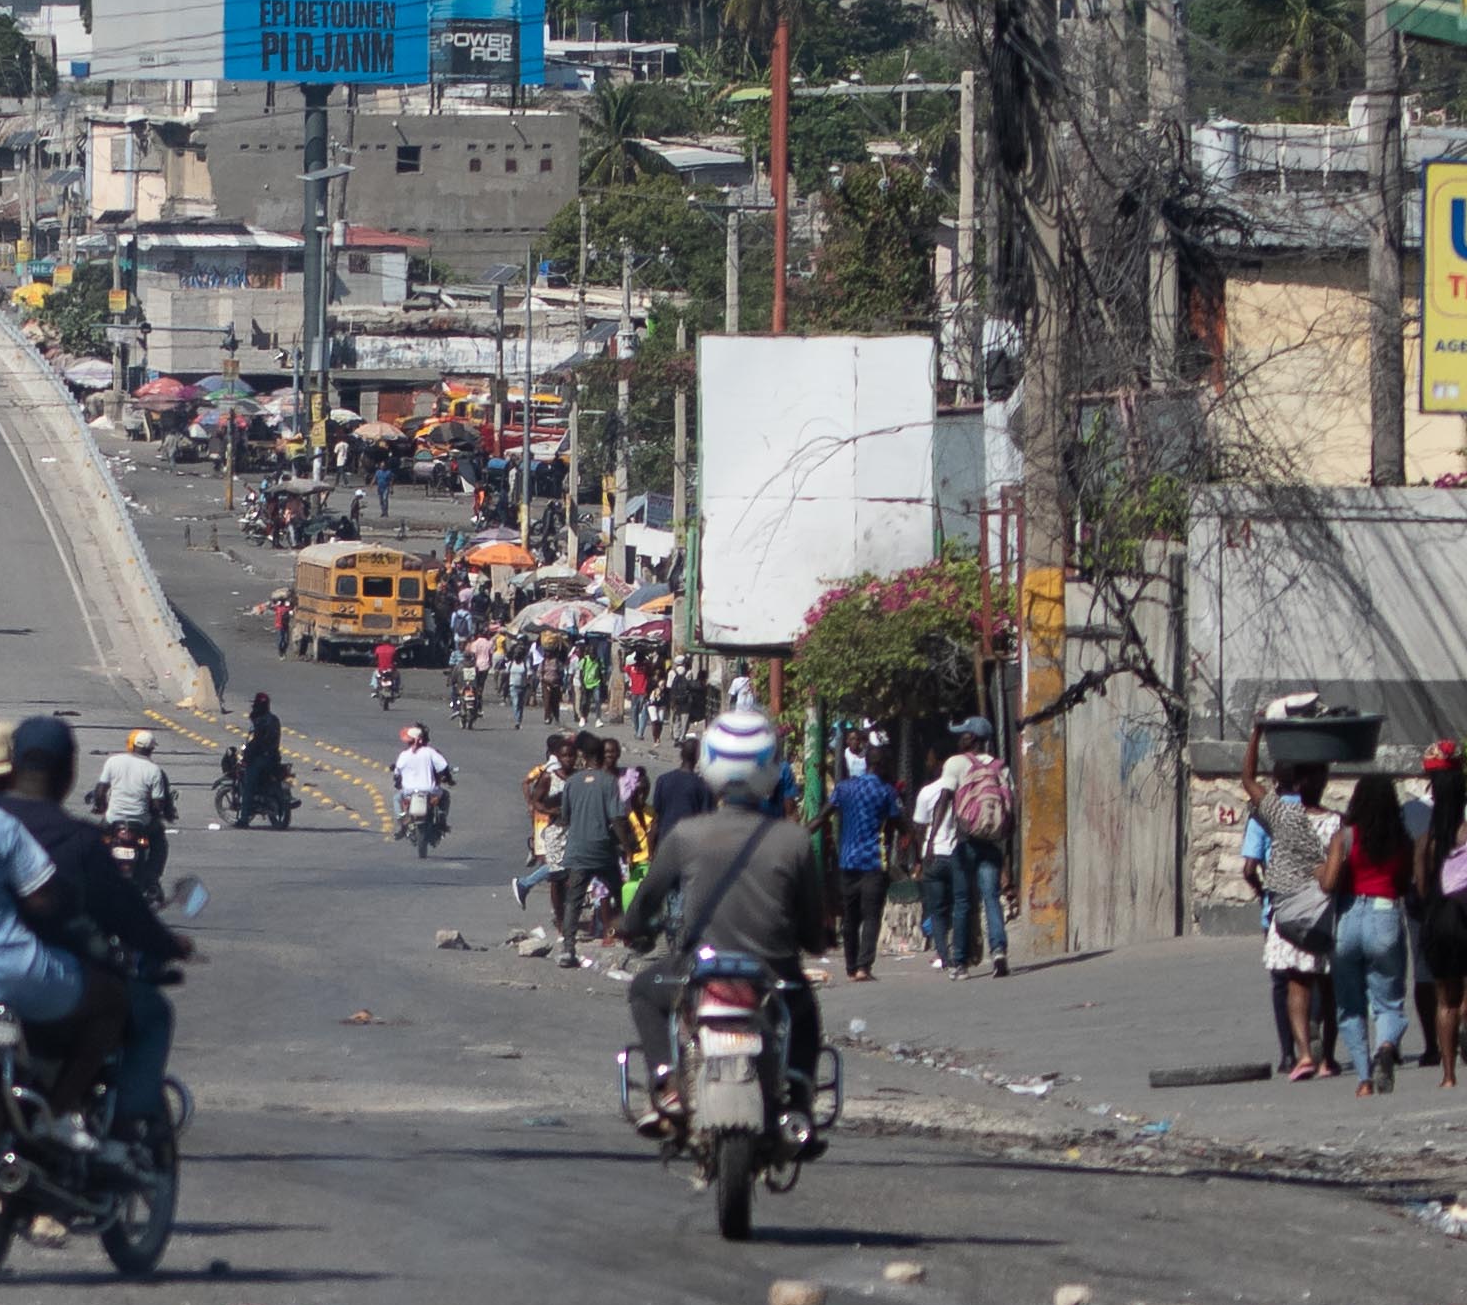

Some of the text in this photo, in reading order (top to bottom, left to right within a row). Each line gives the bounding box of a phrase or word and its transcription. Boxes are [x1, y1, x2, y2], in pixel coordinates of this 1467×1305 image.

[294, 0, 397, 30] RETOUNEN
[440, 32, 513, 48] POWER
[261, 31, 290, 73] PI
[295, 32, 395, 74] DJANM
[470, 46, 514, 62] ADE
